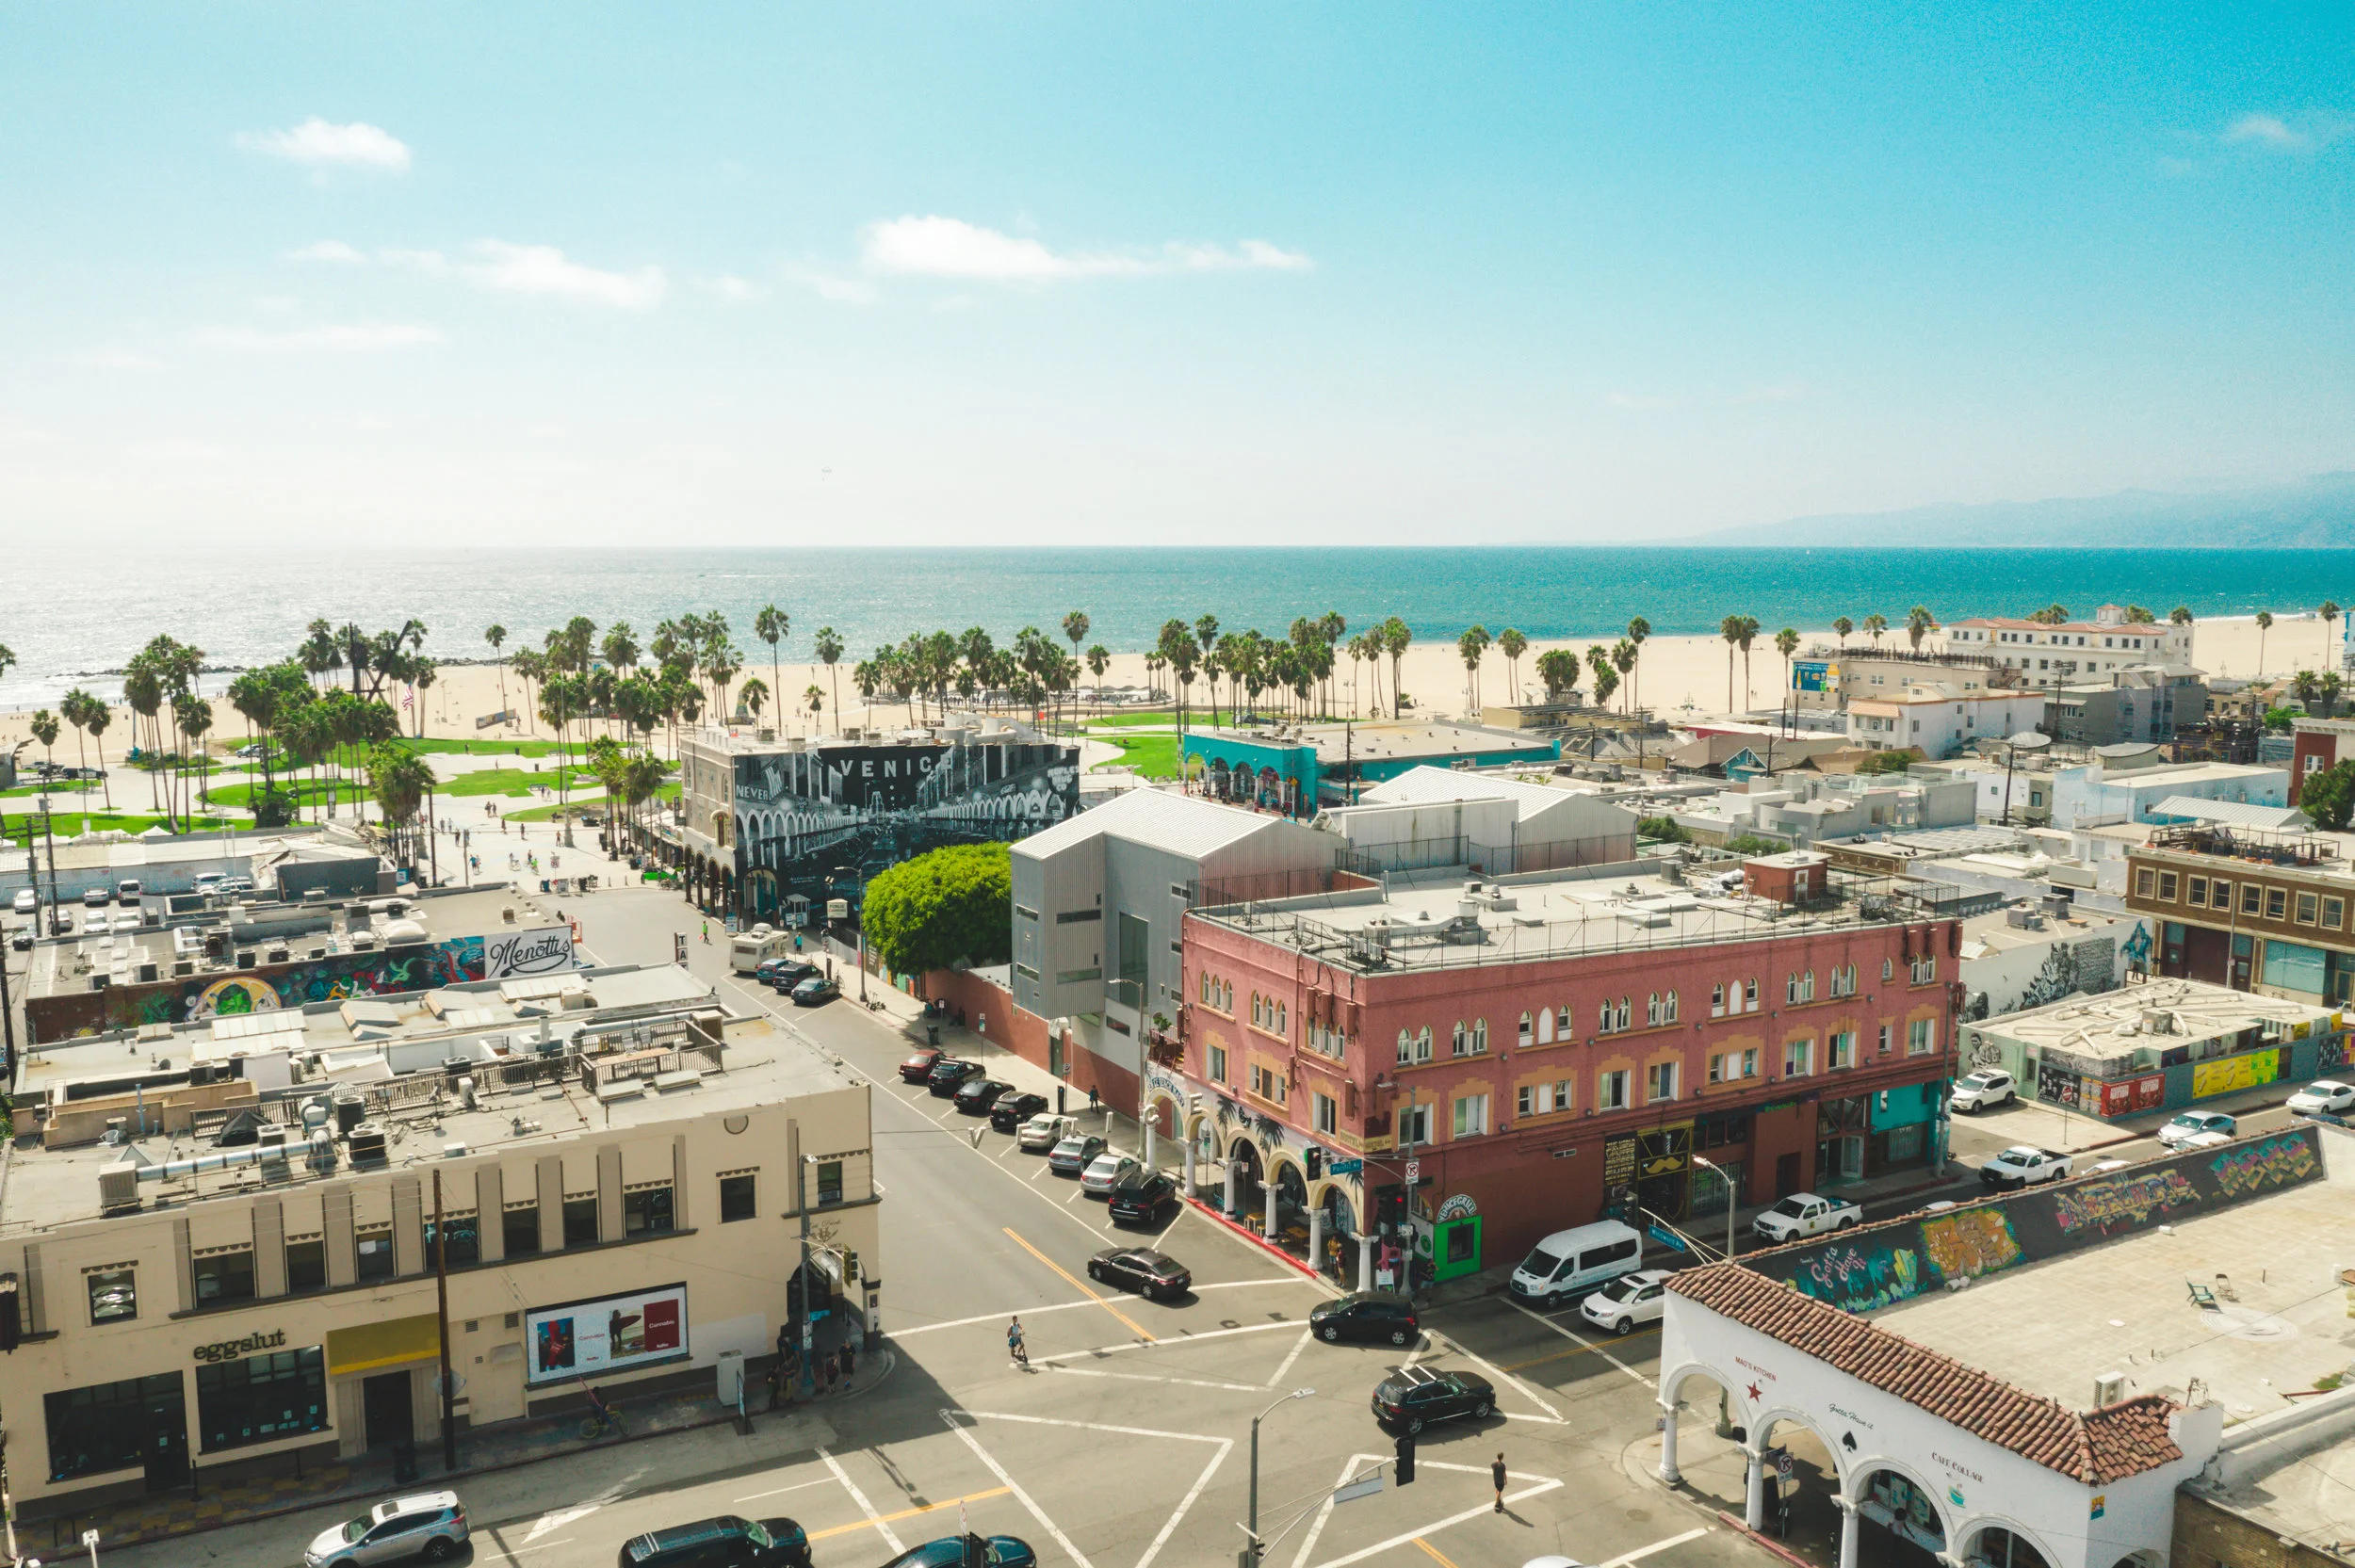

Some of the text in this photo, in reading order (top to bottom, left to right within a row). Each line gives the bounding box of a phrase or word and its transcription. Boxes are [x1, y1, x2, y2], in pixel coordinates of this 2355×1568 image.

[736, 784, 769, 800] NEVER
[193, 1328, 286, 1363] eggslut
[1753, 1365, 1777, 1382] KITCHEN
